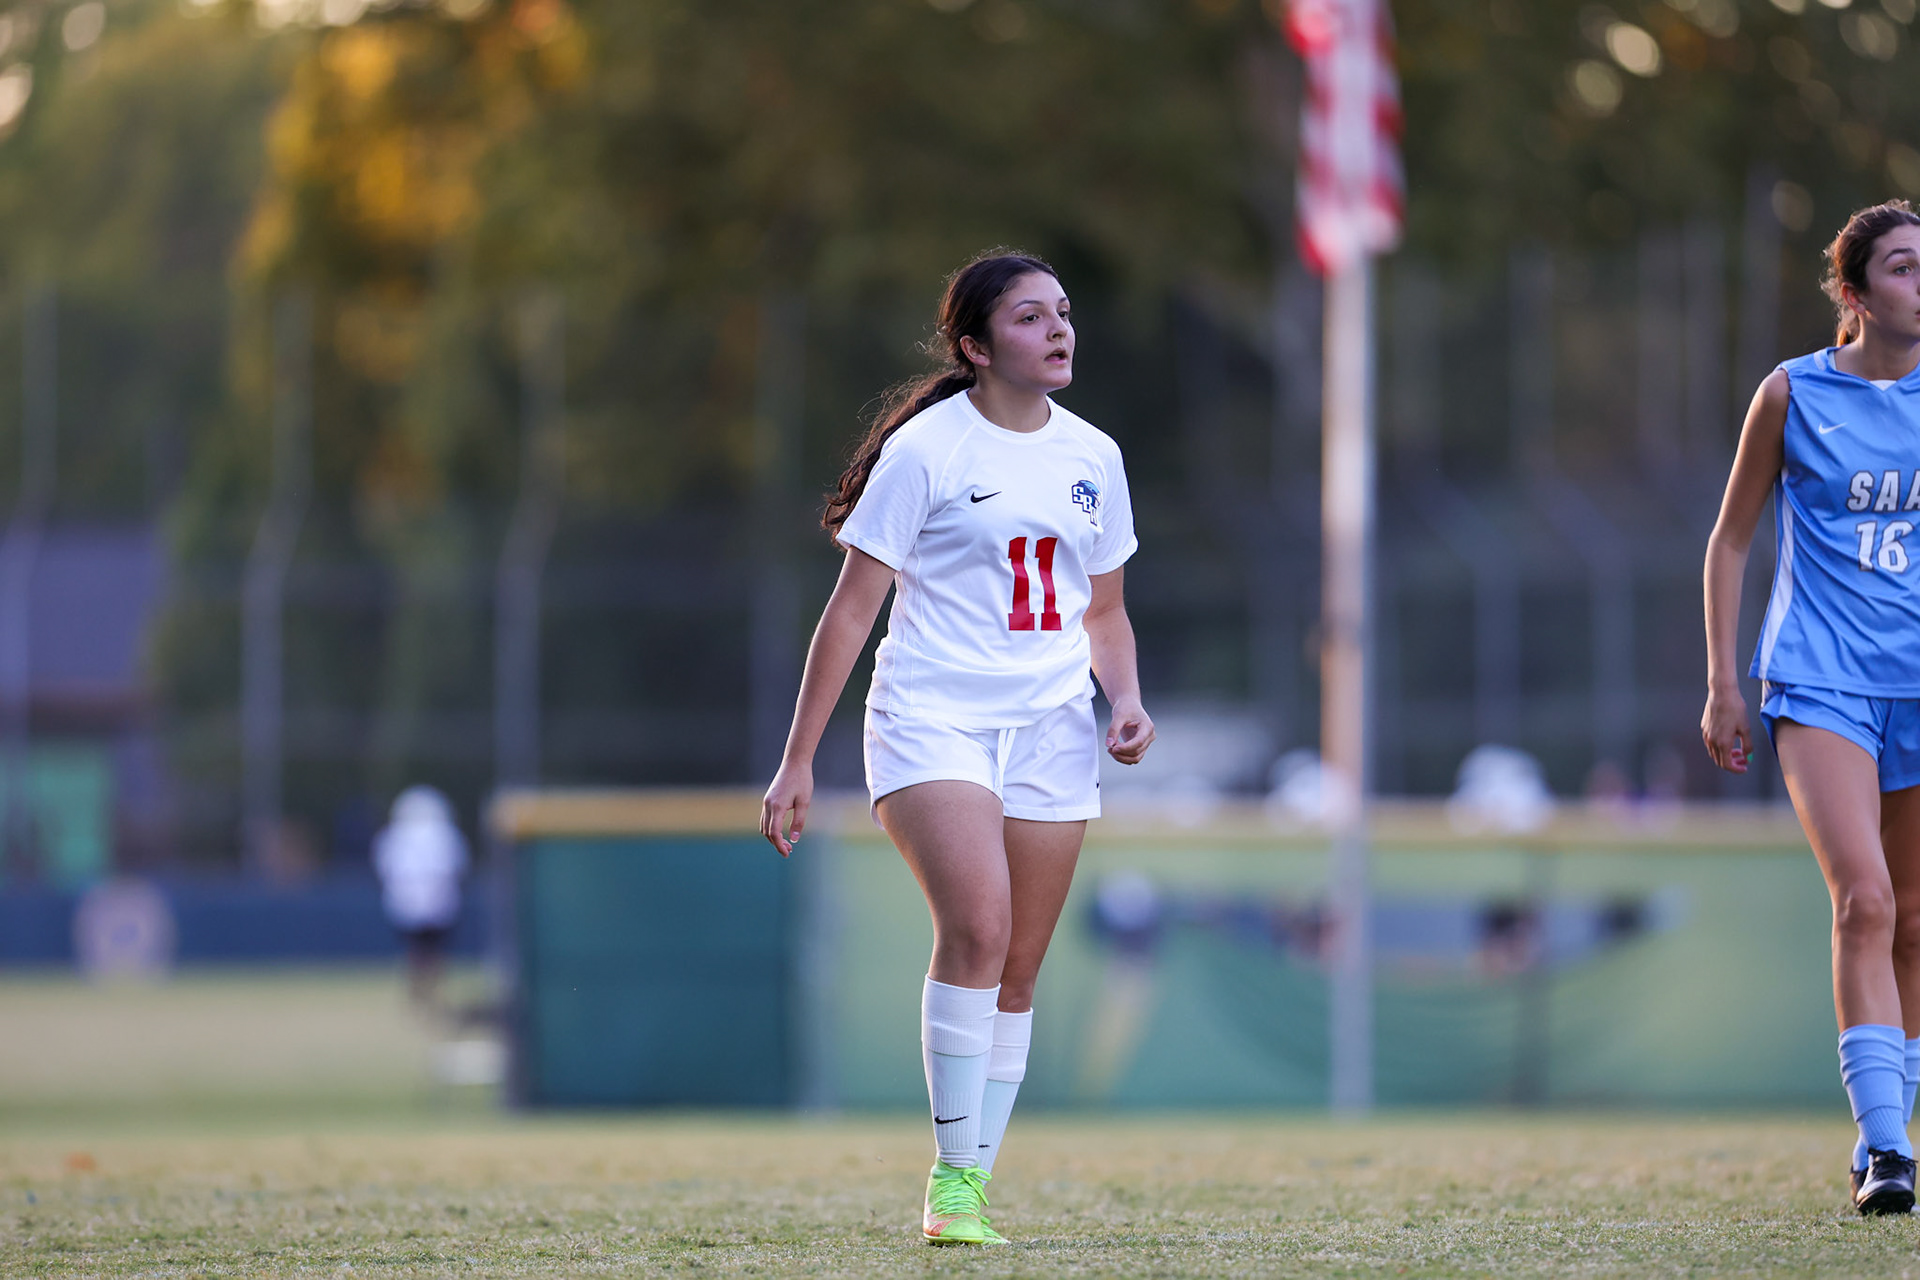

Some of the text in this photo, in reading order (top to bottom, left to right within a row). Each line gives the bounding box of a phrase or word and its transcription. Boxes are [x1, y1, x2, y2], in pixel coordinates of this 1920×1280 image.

[1846, 470, 1920, 512] SAA
[1856, 521, 1914, 573] 16
[1008, 536, 1062, 631] 11
